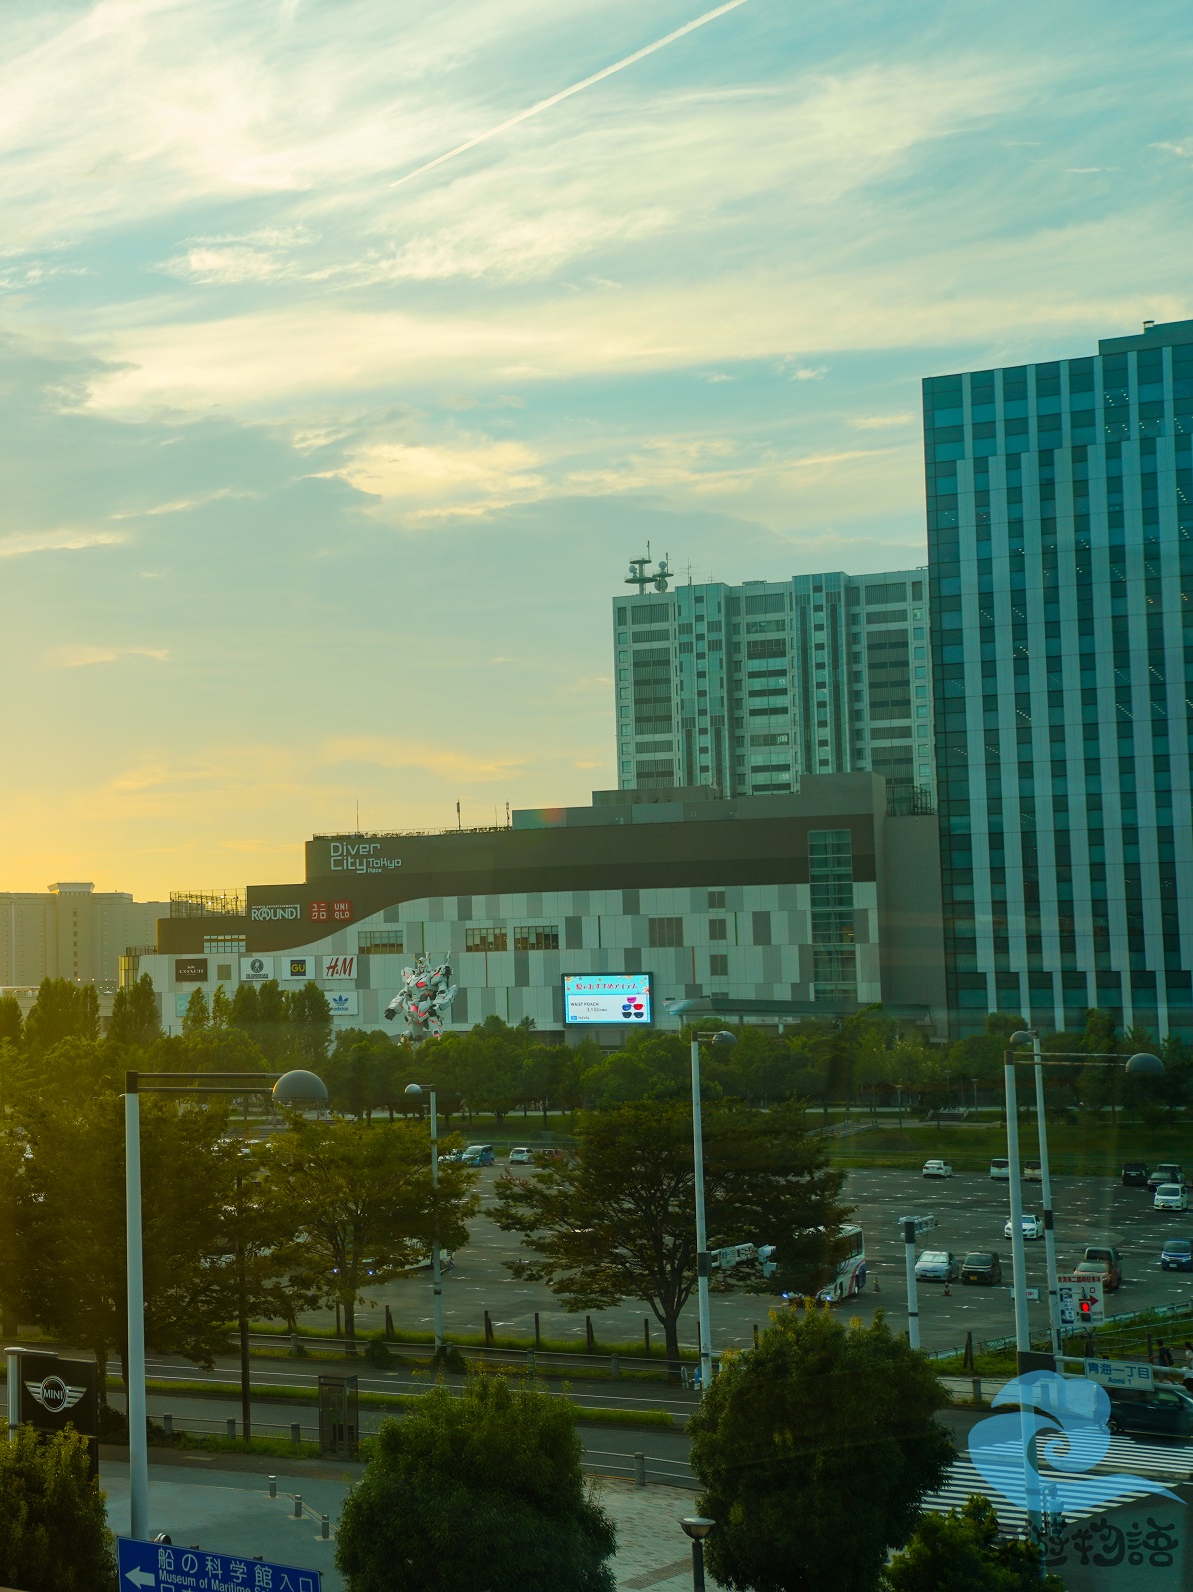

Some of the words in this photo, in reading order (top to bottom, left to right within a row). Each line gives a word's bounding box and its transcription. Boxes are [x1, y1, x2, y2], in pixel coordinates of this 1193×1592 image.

[330, 842, 380, 856] Diver
[330, 856, 367, 873] City
[334, 903, 348, 911] UNI
[334, 911, 350, 919] QLO
[291, 963, 306, 972] GU
[326, 957, 354, 977] H&M
[1088, 1362, 1149, 1379] 青海一丁目
[44, 1389, 63, 1400] MINI
[158, 1548, 313, 1592] 船の科学館入口
[159, 1570, 196, 1587] Museum
[199, 1578, 208, 1589] of
[211, 1579, 250, 1592] Maritime
